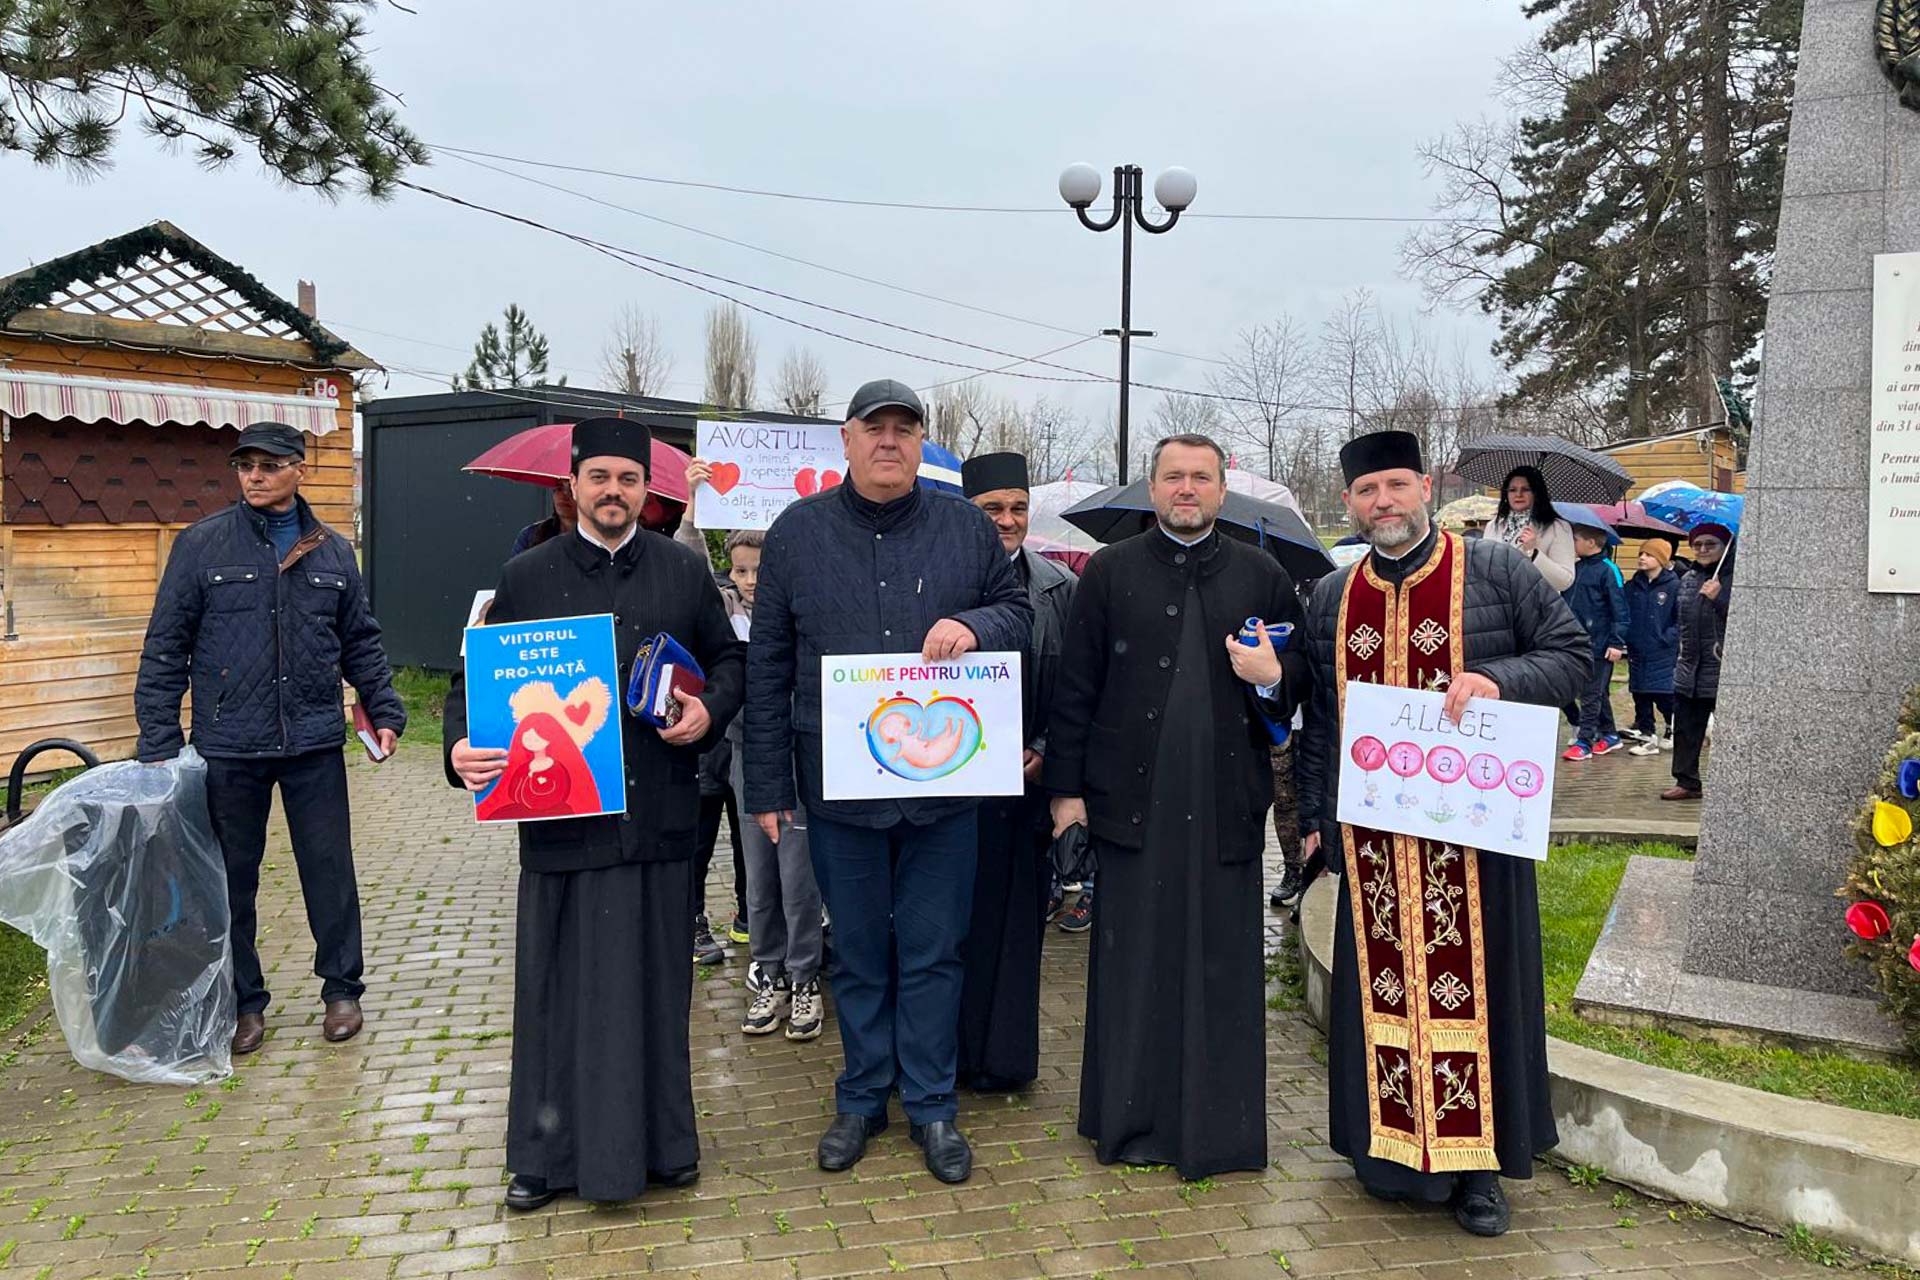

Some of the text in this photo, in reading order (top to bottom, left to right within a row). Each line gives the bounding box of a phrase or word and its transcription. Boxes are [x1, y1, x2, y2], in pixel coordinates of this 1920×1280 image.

[1886, 381, 1898, 392] ai
[1876, 420, 1895, 431] din
[1898, 420, 1912, 431] 31
[799, 454, 816, 465] se
[1880, 475, 1888, 483] o
[741, 510, 758, 521] se
[499, 628, 577, 646] VIITORUL
[519, 646, 560, 661] ESTE
[494, 658, 586, 681] PRO-VIAȚĂ
[832, 661, 1010, 683] O LUME PENTRU VIAȚĂ
[1390, 702, 1498, 742] ALEGE
